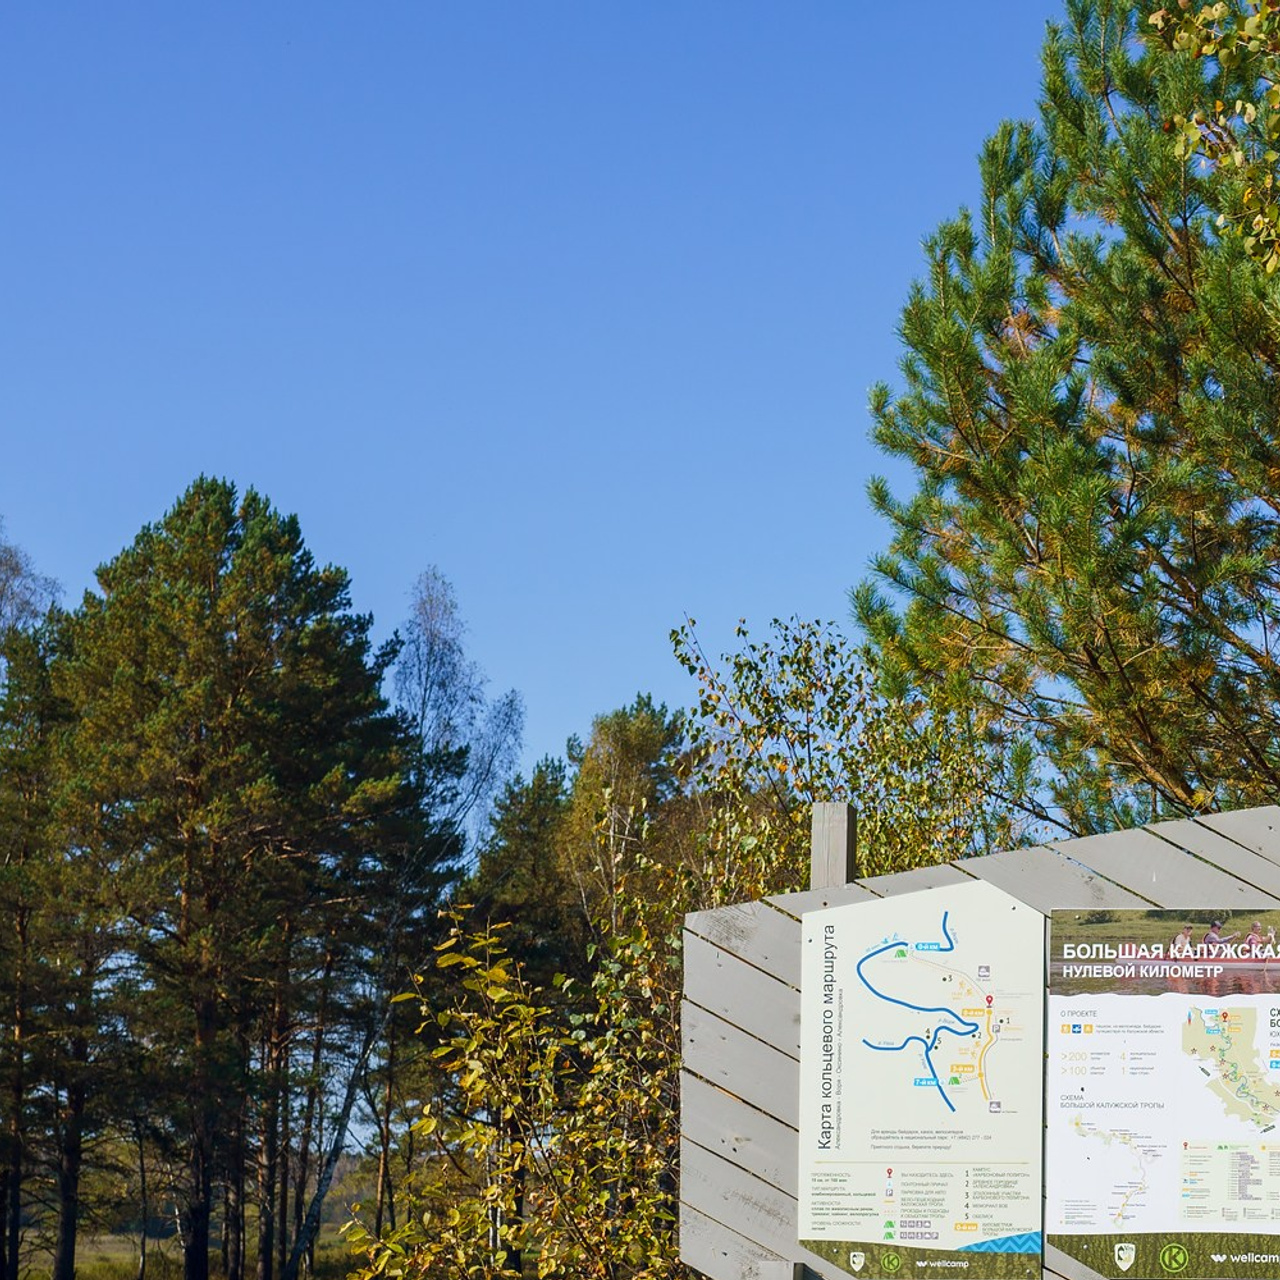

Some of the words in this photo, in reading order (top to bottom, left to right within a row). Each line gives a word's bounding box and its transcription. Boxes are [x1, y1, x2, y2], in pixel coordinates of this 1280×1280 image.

[1063, 943, 1163, 959] БОЛЬШАЯ
[823, 925, 838, 1005] маршрута
[1063, 962, 1135, 978] НУЛЕВОЙ
[1140, 965, 1224, 978] КИЛОМЕТР
[948, 974, 953, 983] 3
[937, 1037, 942, 1045] 5
[821, 1009, 834, 1099] кольцевого
[818, 1103, 835, 1150] Карта
[965, 1169, 970, 1178] 1
[965, 1180, 969, 1188] 2
[964, 1202, 969, 1210] 4
[929, 1259, 969, 1269] wellcamp
